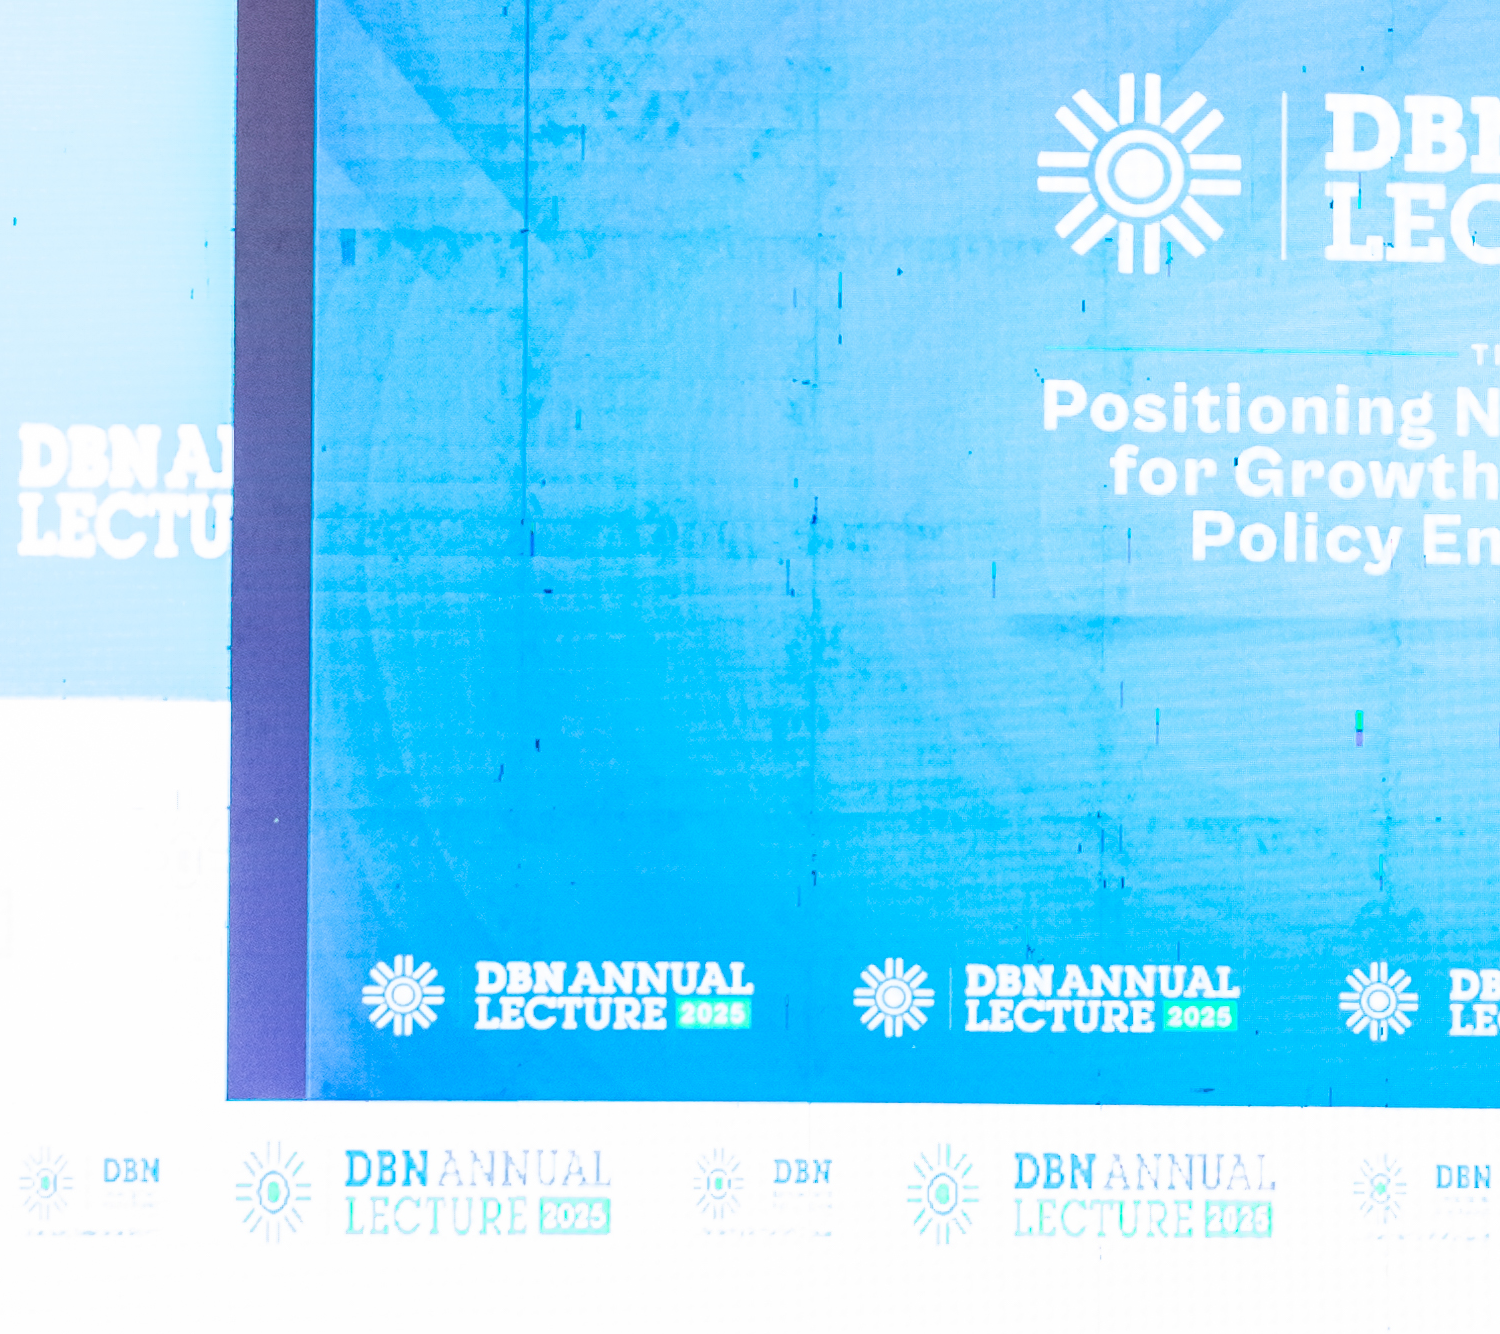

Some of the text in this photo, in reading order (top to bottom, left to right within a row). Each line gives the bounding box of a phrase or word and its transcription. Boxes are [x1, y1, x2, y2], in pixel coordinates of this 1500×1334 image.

[1042, 379, 1436, 452] Positioning
[18, 423, 162, 488] DBN
[1109, 444, 1217, 497] for
[1234, 444, 1500, 502] Growth
[1192, 510, 1401, 576] Policy
[475, 961, 754, 997] DBN ANNUAL
[965, 965, 1240, 1000] DBN ANNUAL
[475, 997, 746, 1032] LECTURE 2025
[965, 1000, 1232, 1035] LECTURE 2025
[104, 1158, 159, 1183] DBN
[345, 1149, 610, 1187] DBN ANNUAL
[774, 1159, 832, 1184] DBN
[1014, 1152, 1275, 1190] DBN ANNUAL
[1436, 1164, 1491, 1189] DBN
[346, 1196, 608, 1235] LECTURE 2025
[1015, 1199, 1193, 1238] LECTURE
